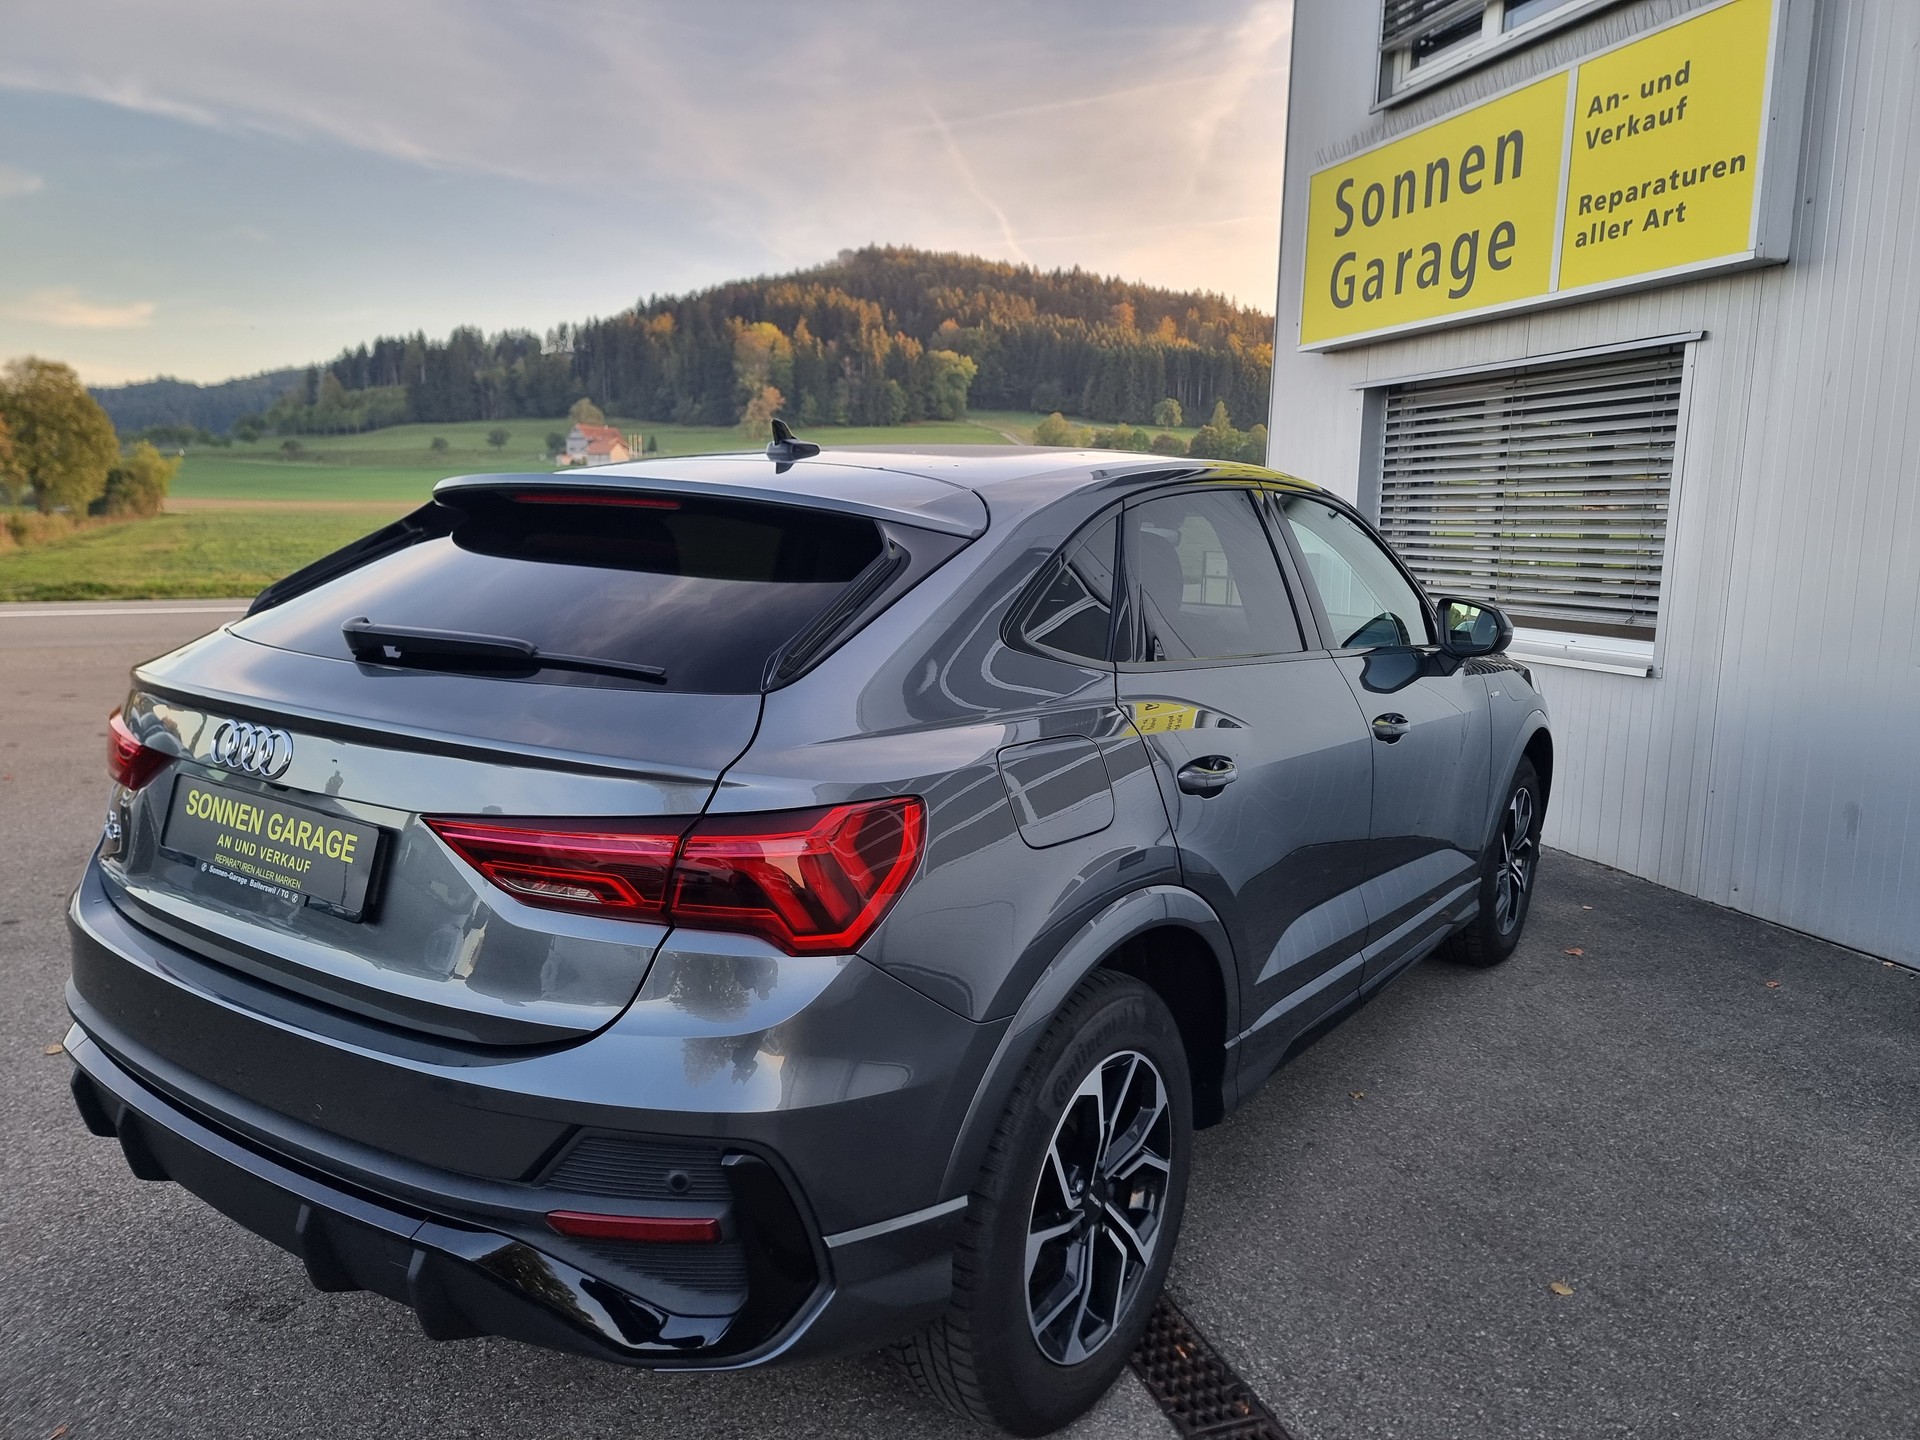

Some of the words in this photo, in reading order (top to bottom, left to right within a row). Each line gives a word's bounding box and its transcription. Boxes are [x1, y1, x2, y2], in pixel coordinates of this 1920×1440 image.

[1586, 92, 1630, 118] An-
[1639, 60, 1691, 100] und
[1585, 98, 1689, 150] Verkauf
[1334, 127, 1525, 237] Sonnen
[1578, 152, 1747, 216] Reparaturen
[1575, 216, 1633, 248] aller
[1642, 200, 1687, 232] Art
[1329, 219, 1517, 309] Garage
[186, 789, 265, 835] SONNEN
[267, 812, 358, 864] GARAGE
[216, 833, 232, 849] AN
[234, 838, 257, 857] UND
[260, 848, 312, 874] VERKAUF
[208, 865, 247, 885] Sonnen-Garage
[281, 889, 289, 899] TG
[256, 866, 275, 879] ALLER
[275, 874, 302, 889] MARKEN
